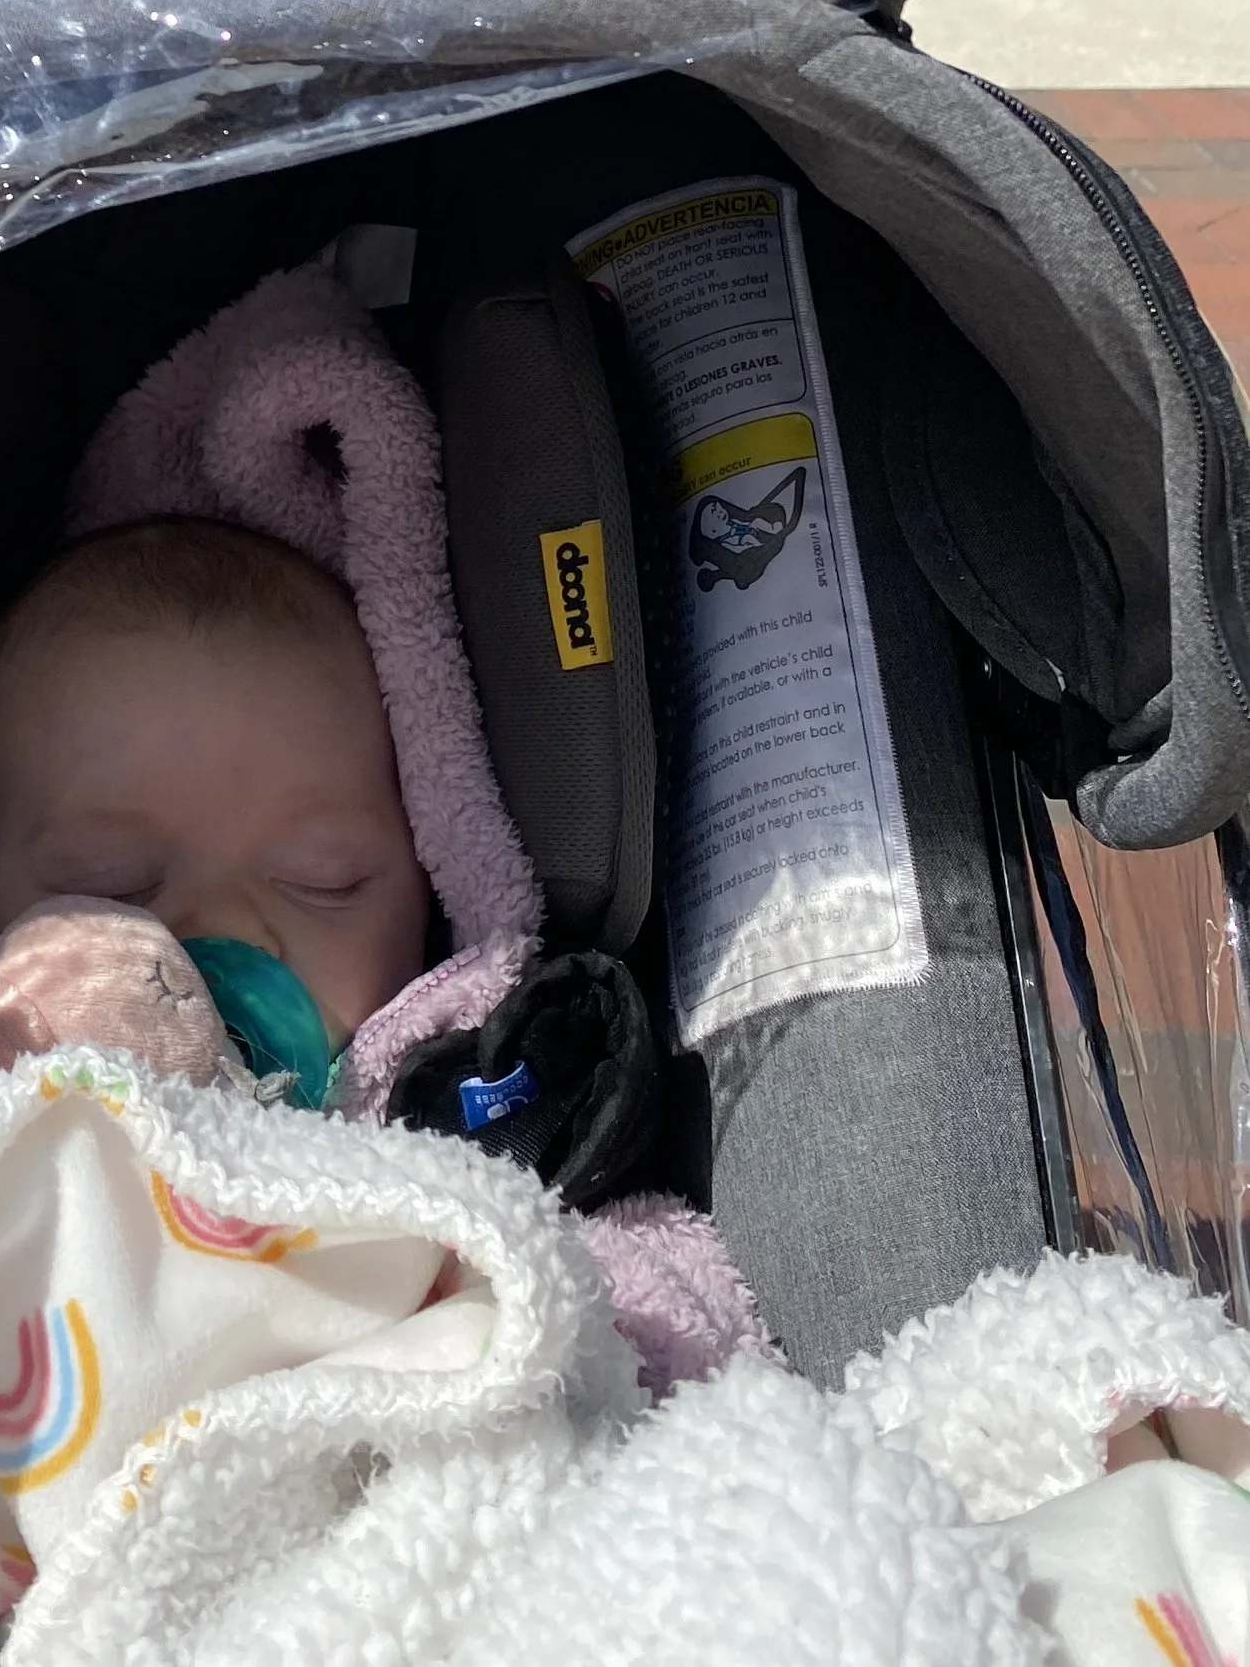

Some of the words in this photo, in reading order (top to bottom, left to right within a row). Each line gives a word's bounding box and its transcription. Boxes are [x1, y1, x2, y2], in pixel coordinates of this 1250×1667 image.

[622, 193, 770, 249] ADVERTENCIA
[617, 254, 633, 269] DO
[635, 246, 654, 259] NOT
[657, 259, 692, 280] DEATH
[695, 251, 713, 266] OR
[717, 243, 768, 261] SERIOUS
[668, 249, 682, 261] on
[685, 239, 711, 256] front
[715, 231, 742, 245] seat
[659, 282, 679, 296] can
[681, 268, 719, 286] occur.
[708, 278, 729, 293] the
[732, 272, 768, 288] safest
[674, 300, 718, 323] children
[722, 292, 736, 305] 12
[739, 288, 766, 301] and
[696, 337, 727, 355] hacia
[729, 328, 758, 344] atrás
[762, 327, 778, 337] en
[684, 366, 728, 393] LESIONES
[730, 354, 782, 374] GRAVES.
[691, 386, 723, 406] seguro
[726, 376, 753, 395] para
[756, 371, 772, 383] los
[700, 471, 716, 484] can
[719, 456, 752, 476] occur
[557, 542, 595, 648] doona
[703, 634, 736, 663] provided
[737, 625, 758, 642] with
[760, 618, 779, 634] this
[781, 610, 813, 628] child
[731, 670, 746, 685] the
[748, 651, 798, 676] vehicle's
[801, 644, 834, 662] child
[727, 679, 774, 707] available,
[776, 674, 789, 687] or
[791, 667, 819, 683] with
[822, 666, 832, 677] a
[719, 734, 732, 749] this
[733, 723, 754, 743] child
[755, 709, 800, 733] restraint
[803, 703, 830, 720] and
[833, 701, 846, 714] in
[711, 752, 740, 775] located
[741, 748, 754, 760] on
[755, 738, 772, 753] the
[773, 728, 806, 747] lower
[809, 721, 846, 739] back
[753, 780, 770, 796] the
[771, 759, 861, 787] manufacturer.
[738, 806, 756, 826] seat
[756, 795, 786, 815] when
[789, 785, 827, 806] child's
[767, 810, 803, 831] height
[806, 799, 865, 821] exceeds
[743, 859, 778, 883] securely
[777, 848, 817, 871] locked
[818, 843, 848, 859] onto
[843, 882, 872, 897] and
